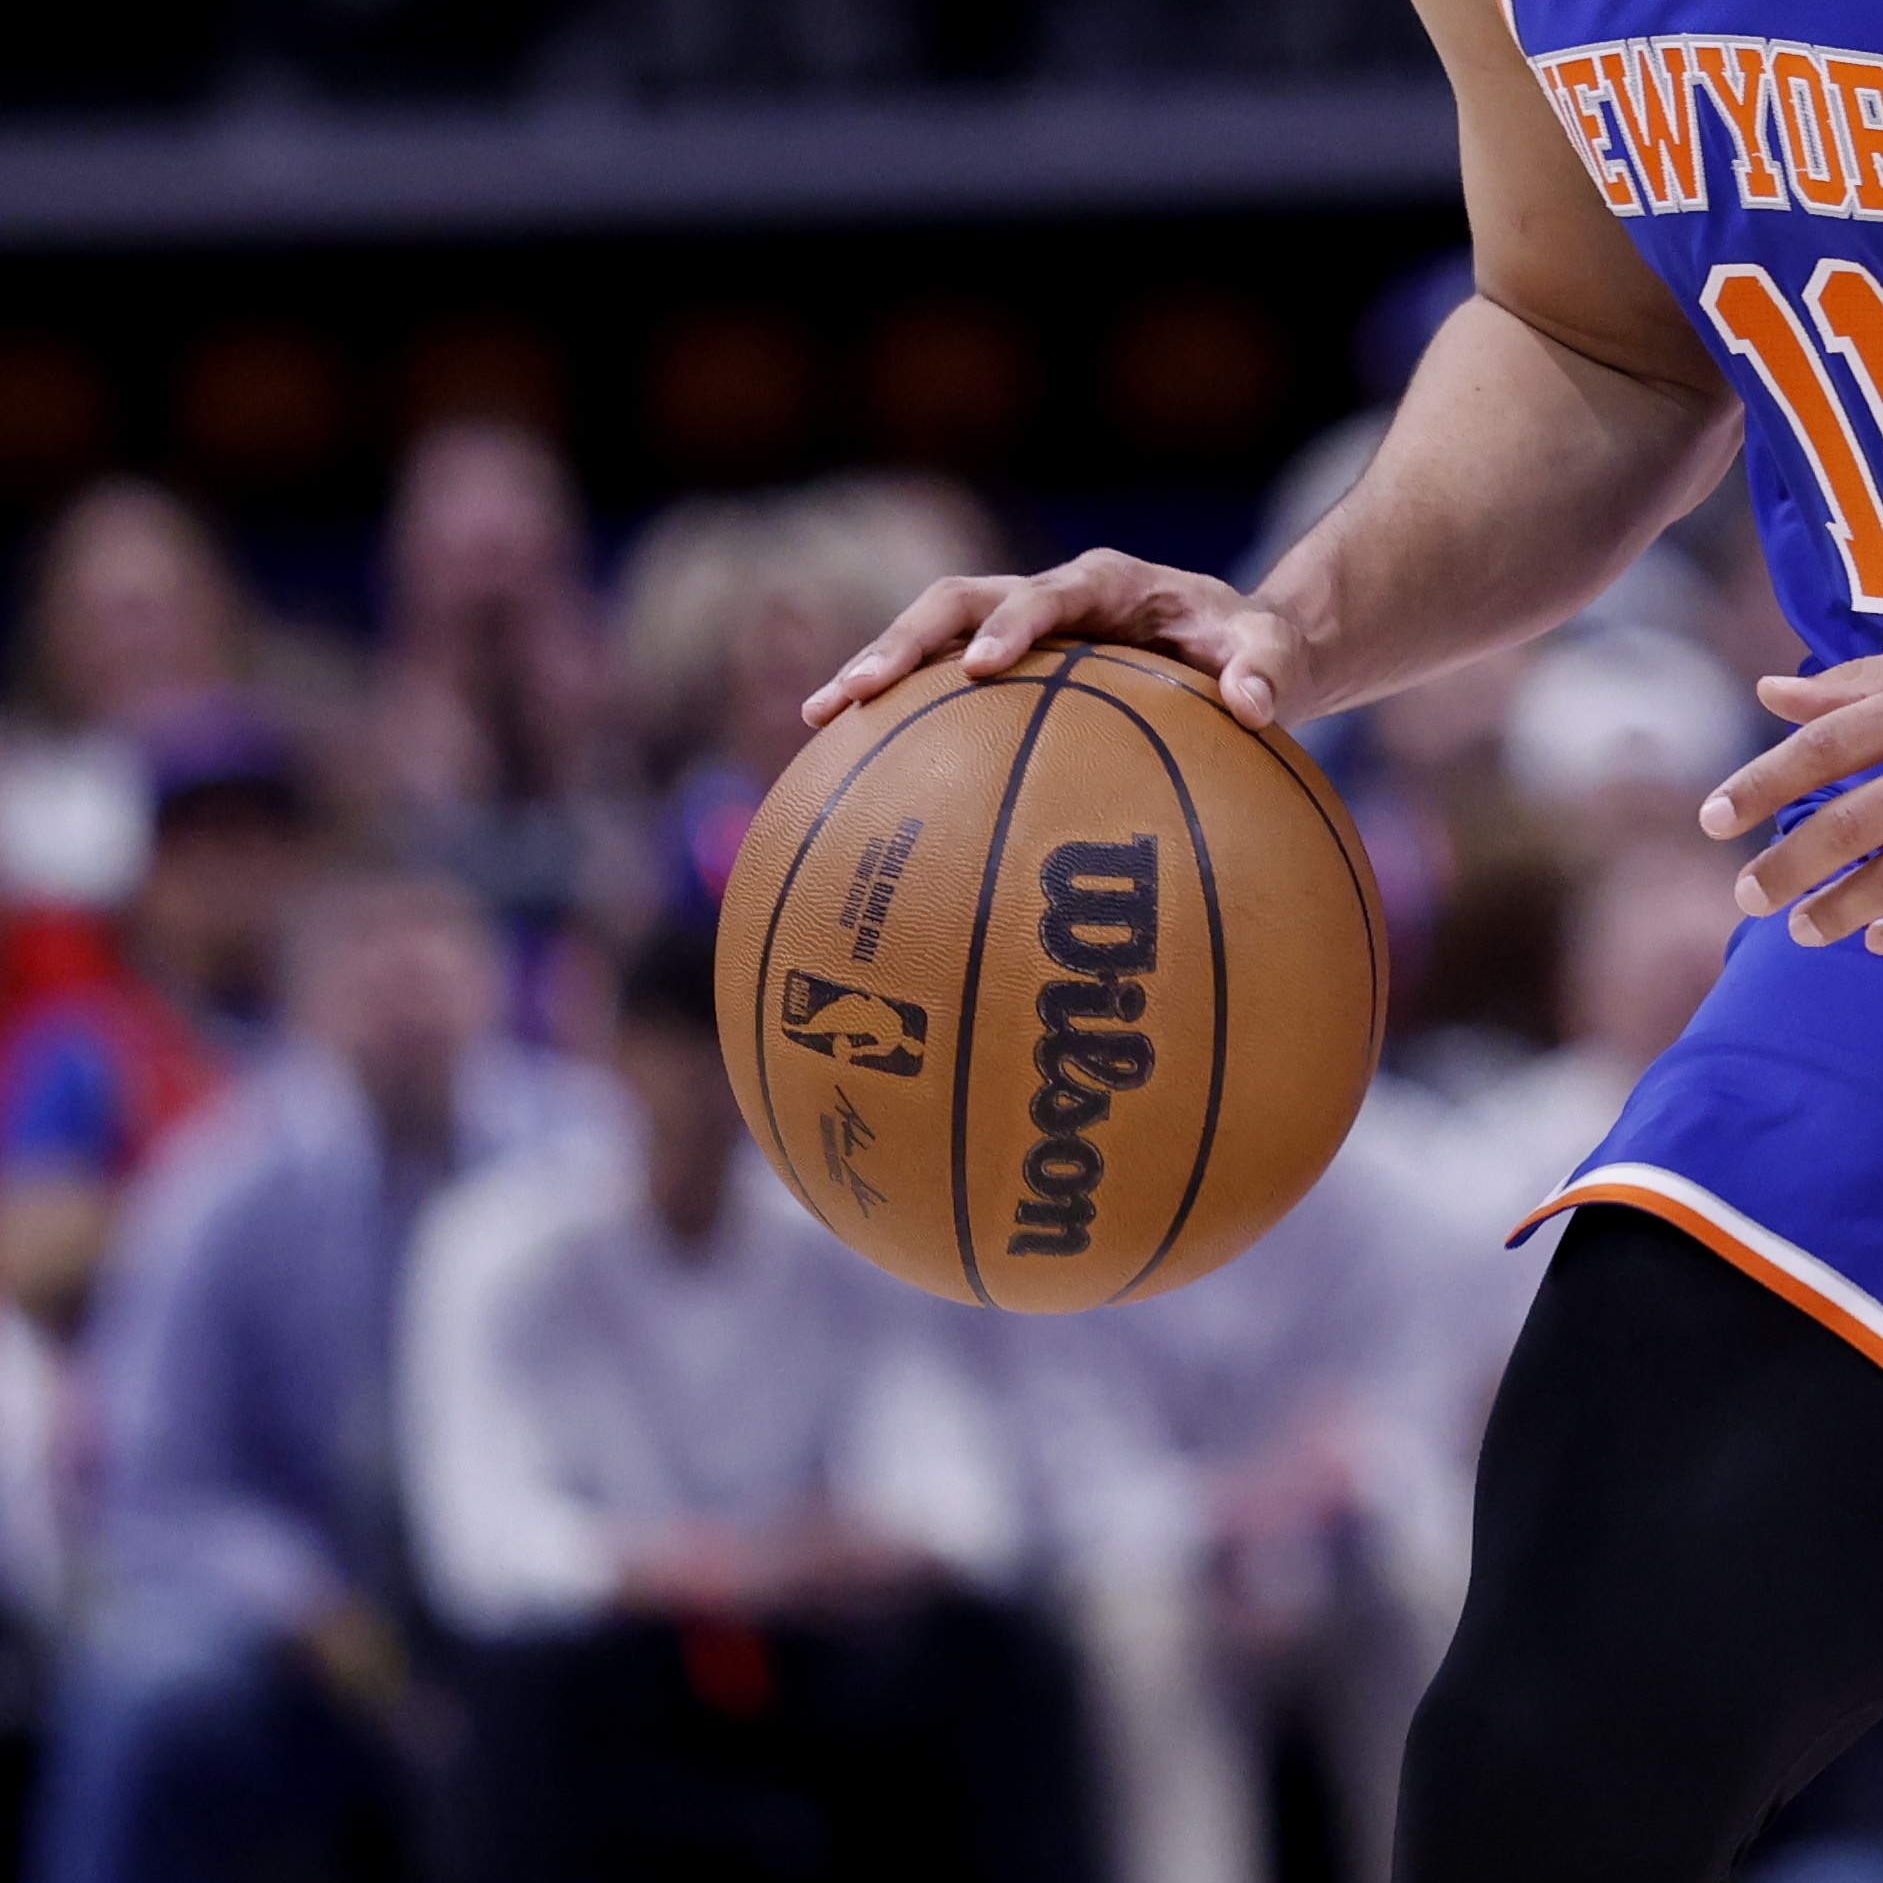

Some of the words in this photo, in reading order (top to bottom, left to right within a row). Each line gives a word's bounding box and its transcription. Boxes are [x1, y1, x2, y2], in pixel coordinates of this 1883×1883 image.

[1527, 34, 1708, 217] EW
[852, 926, 880, 964] BALL
[1006, 832, 1158, 1258] Wilson
